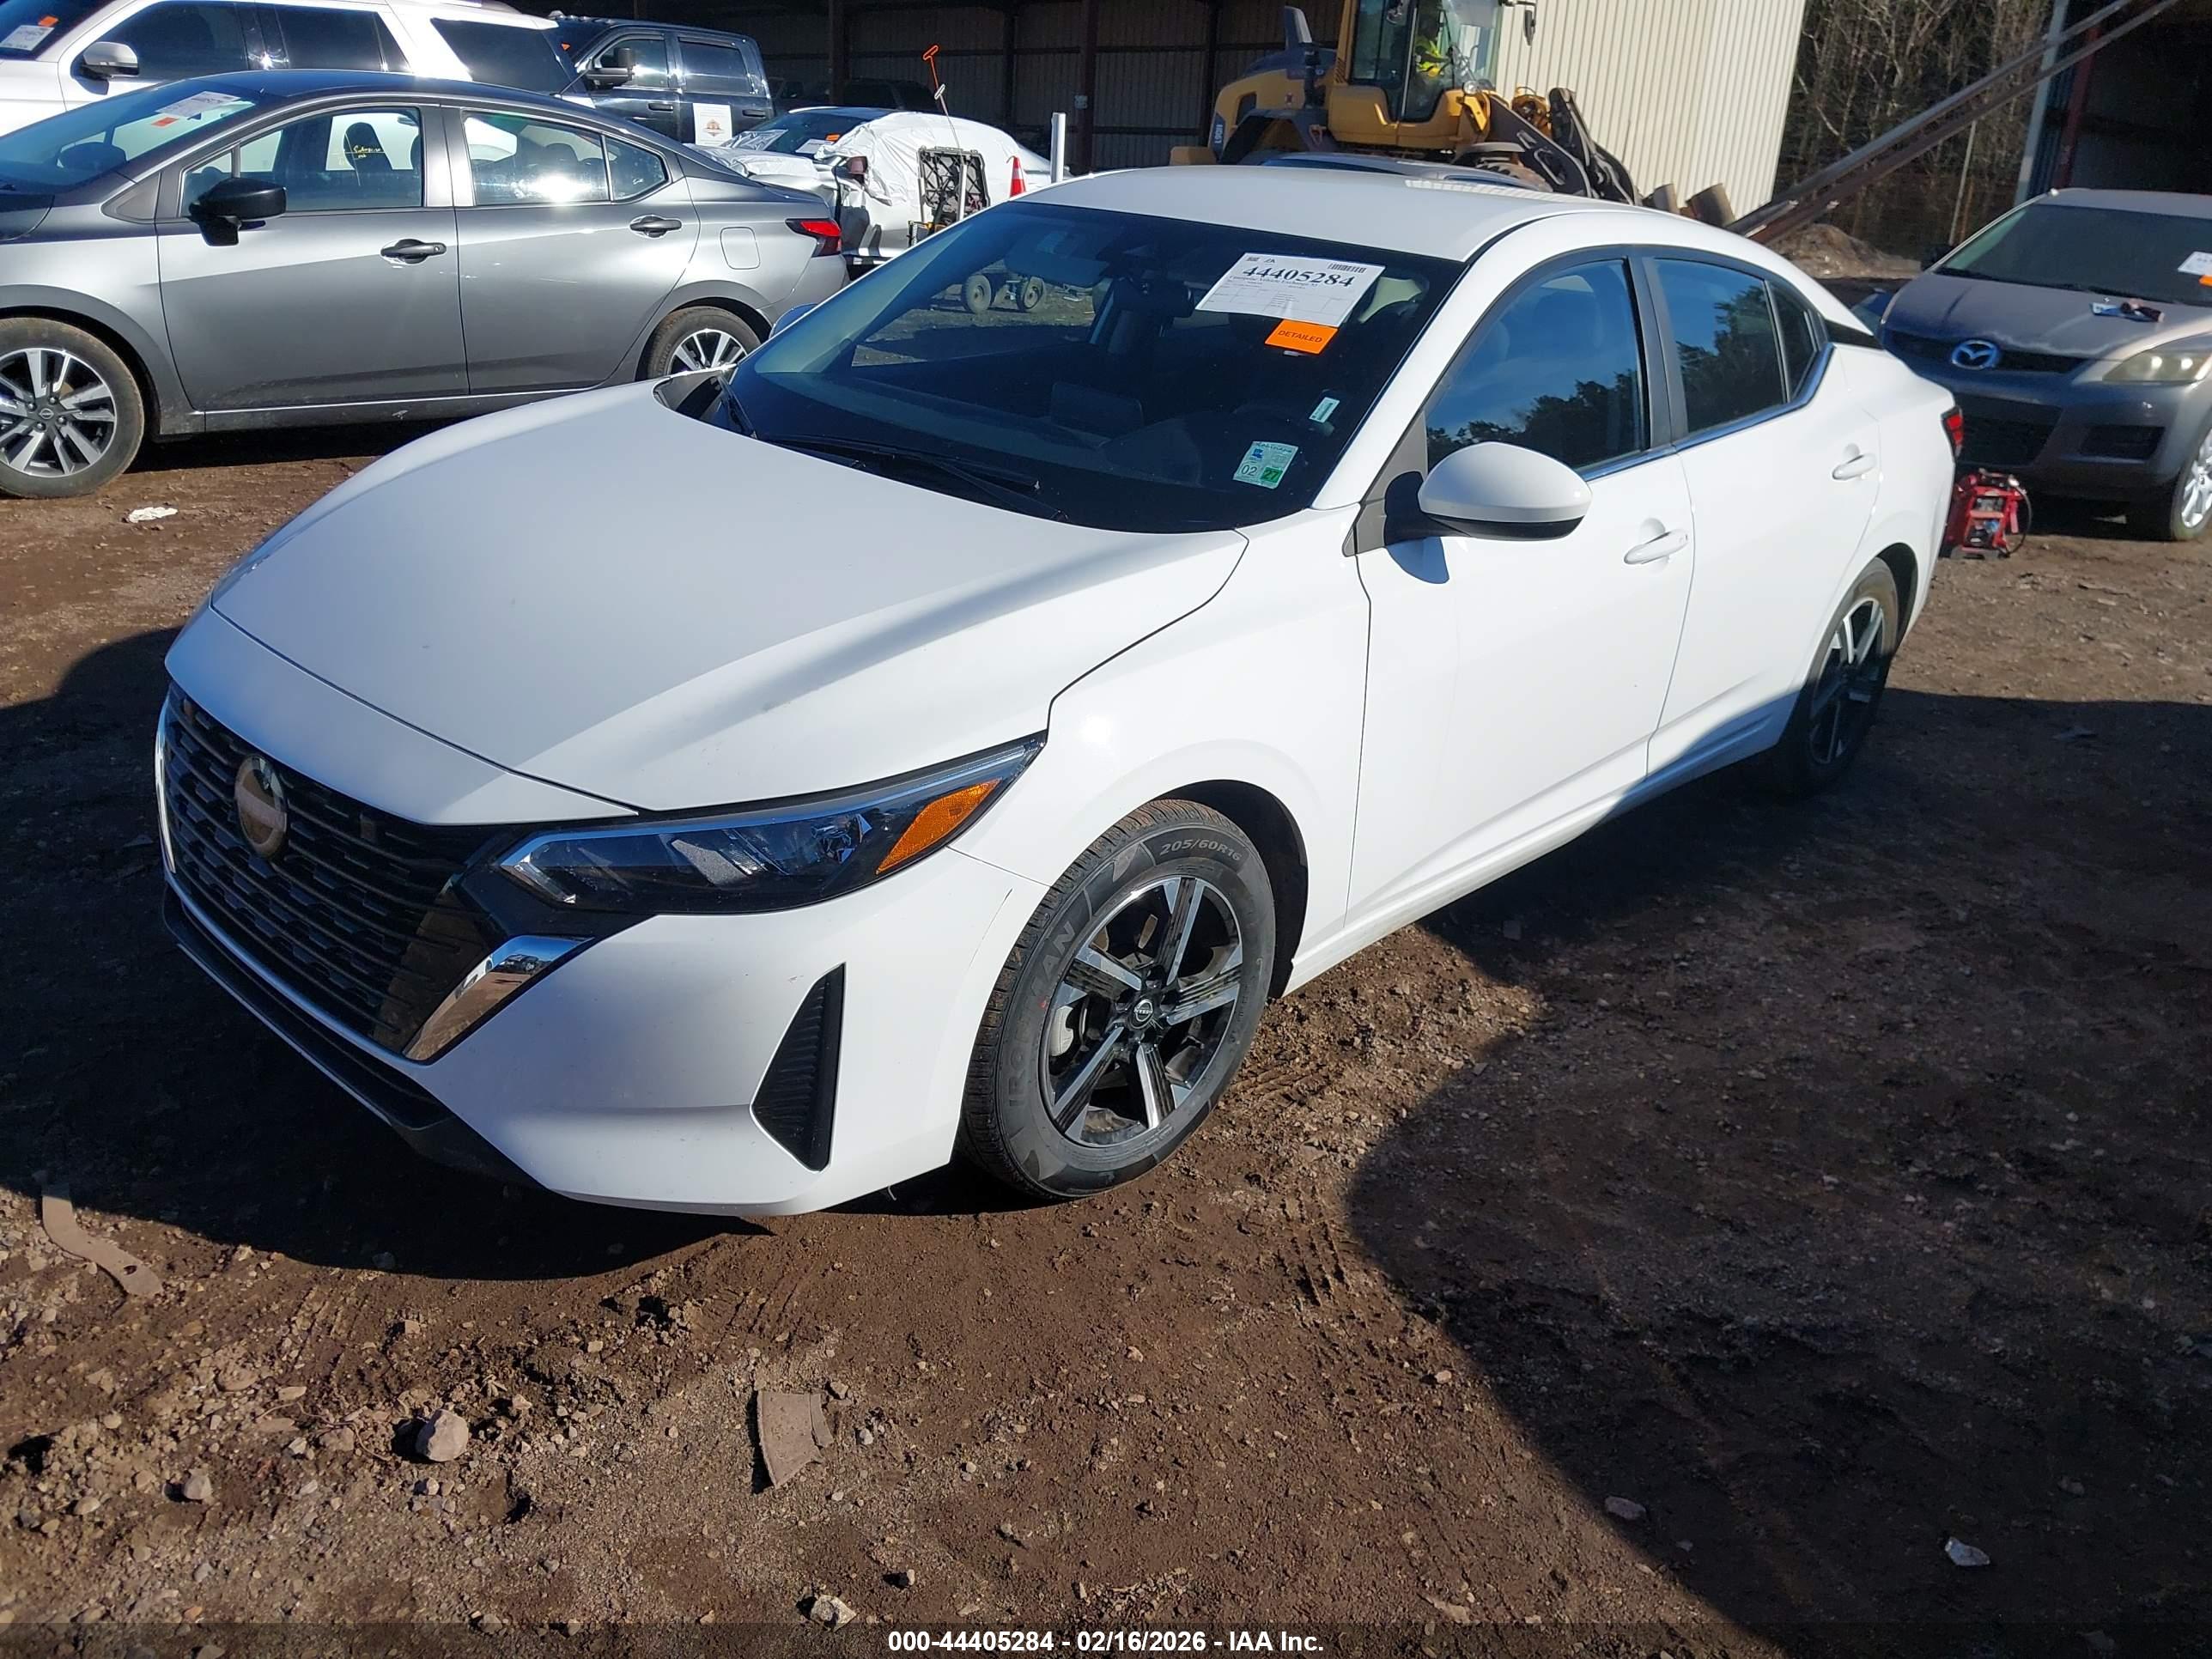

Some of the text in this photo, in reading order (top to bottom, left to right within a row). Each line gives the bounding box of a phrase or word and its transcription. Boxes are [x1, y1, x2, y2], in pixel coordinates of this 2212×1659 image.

[1243, 265, 1356, 288] 44405284
[1278, 329, 1322, 343] DETAILED
[1241, 465, 1258, 477] 02
[1264, 471, 1280, 481] 27
[1159, 839, 1243, 861] 205/60R16
